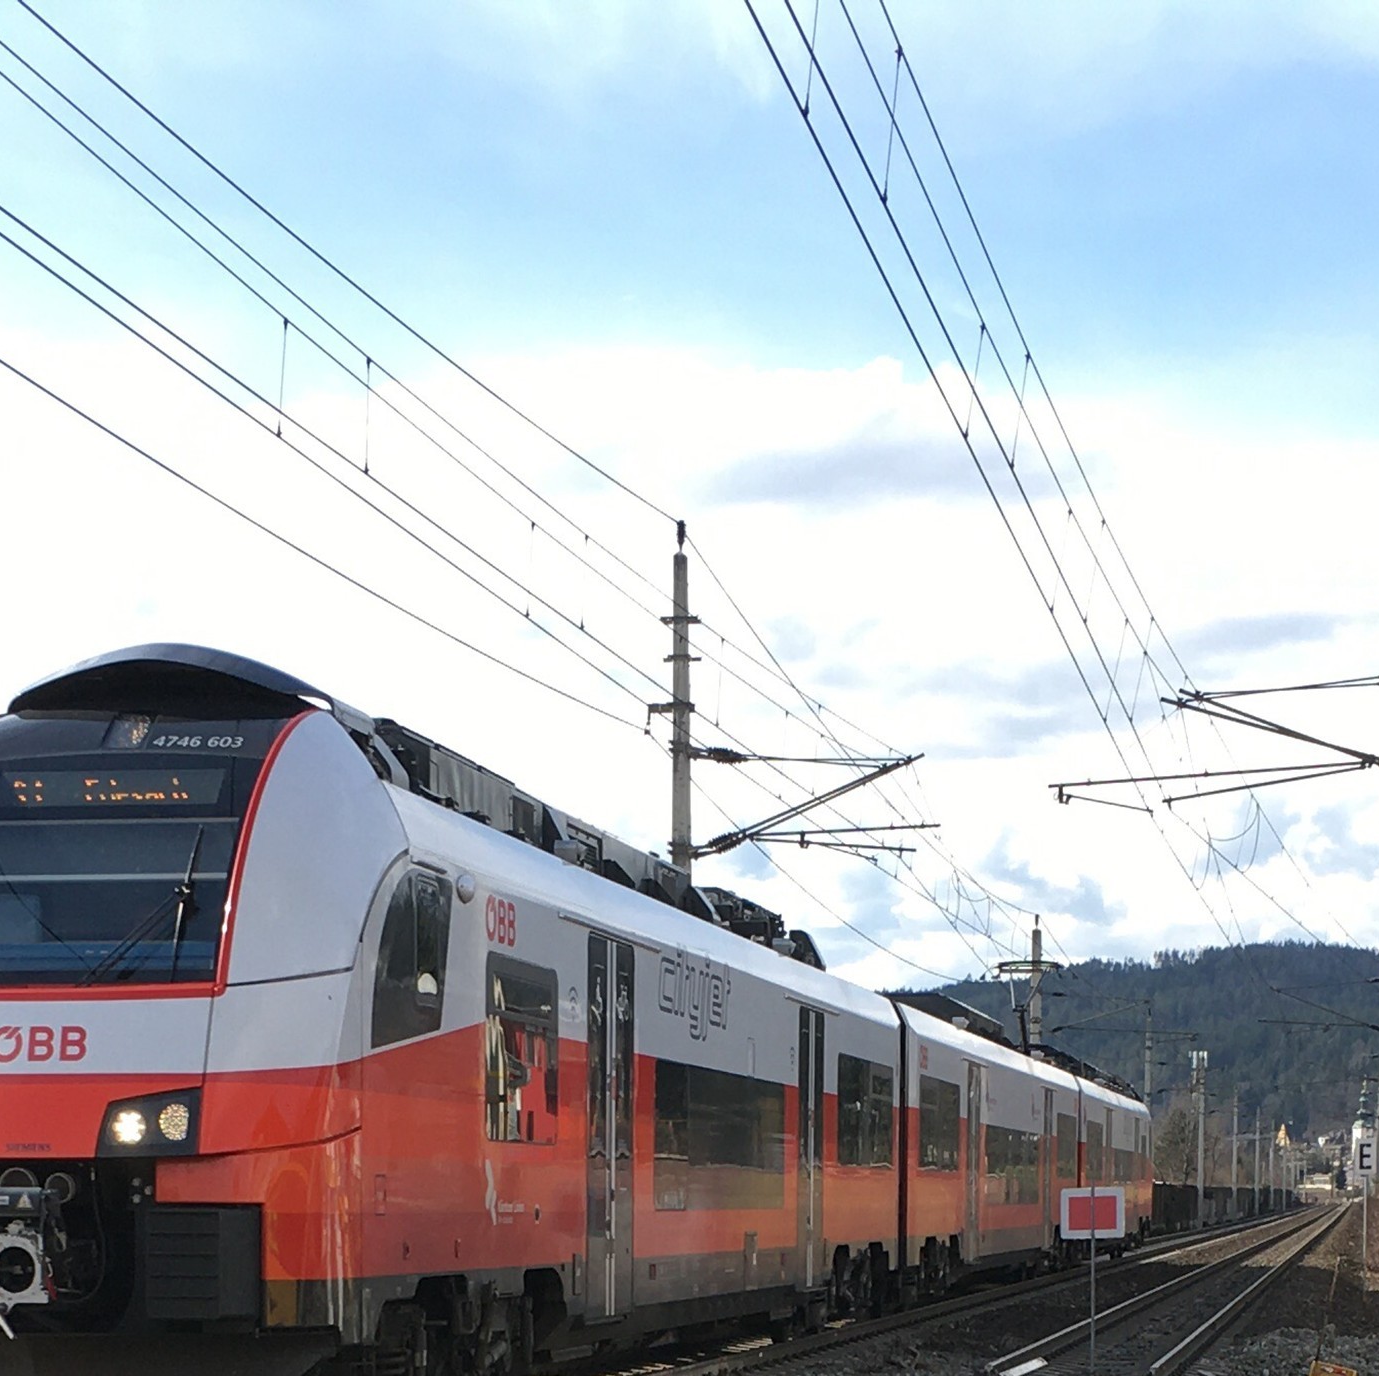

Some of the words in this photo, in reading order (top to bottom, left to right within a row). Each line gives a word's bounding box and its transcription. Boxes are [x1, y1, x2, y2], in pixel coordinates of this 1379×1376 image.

[152, 735, 201, 748] 4746
[207, 736, 244, 748] 603
[485, 894, 517, 948] ÖBB
[1359, 1143, 1372, 1170] E
